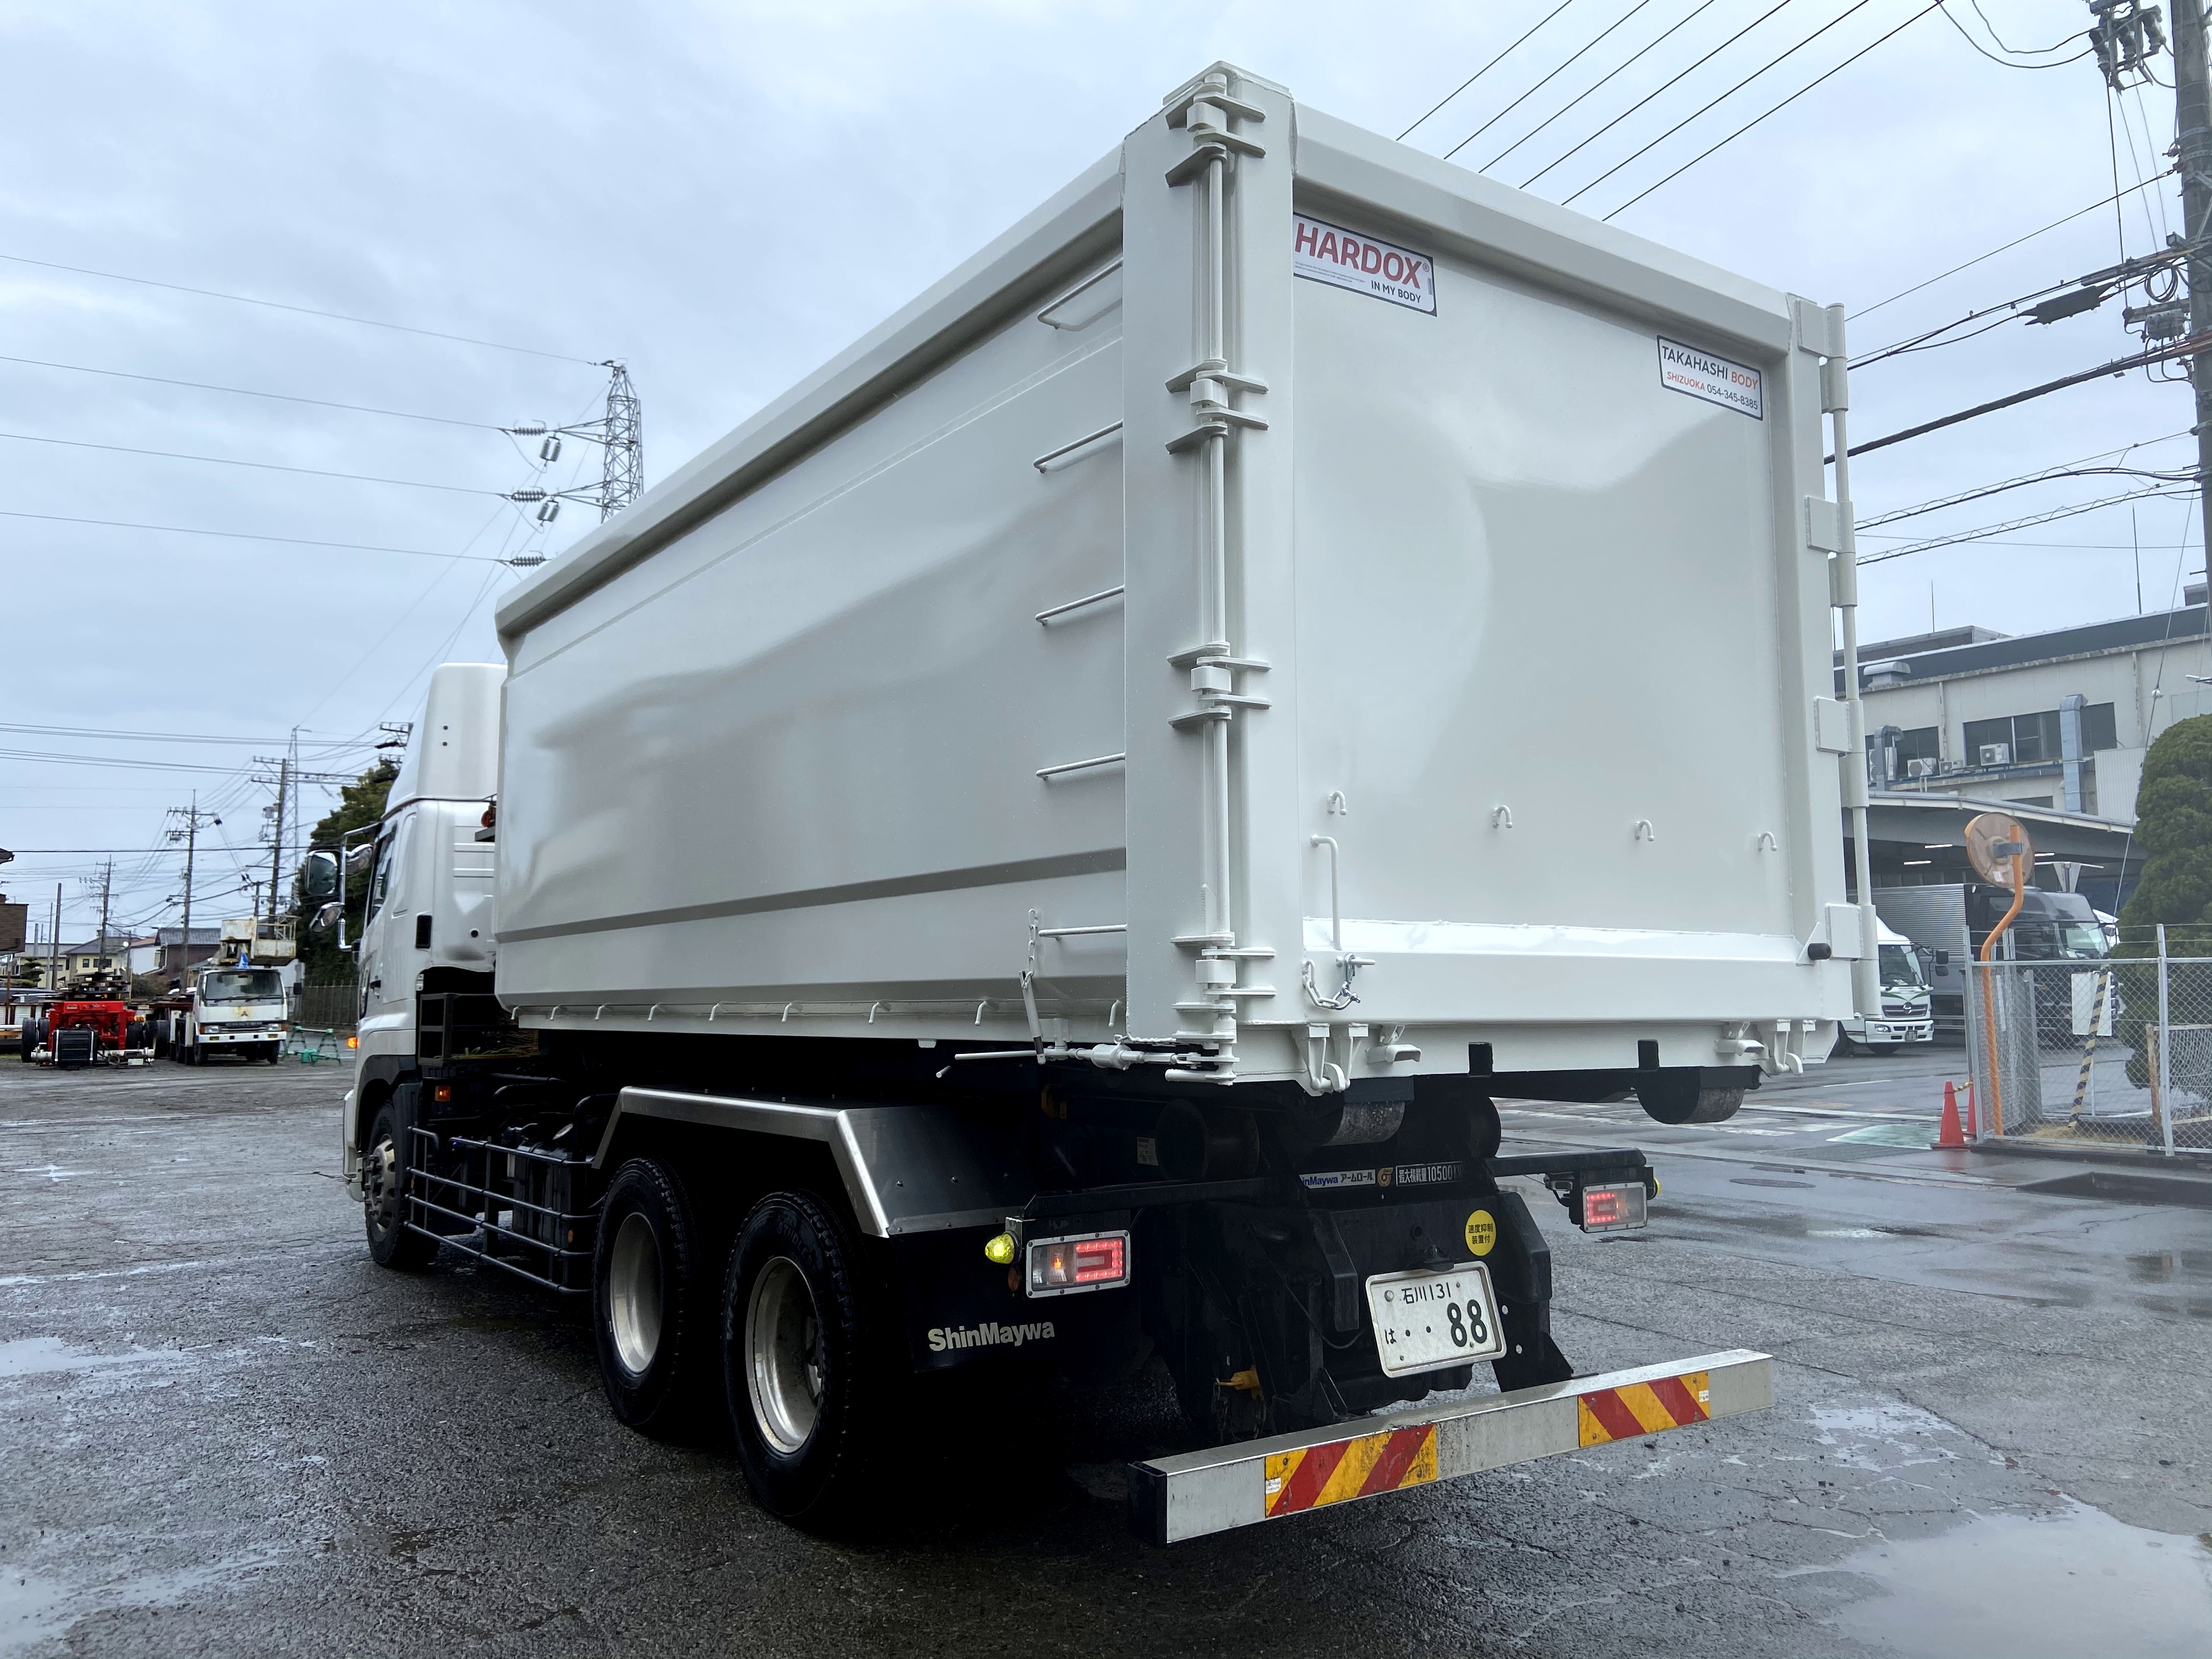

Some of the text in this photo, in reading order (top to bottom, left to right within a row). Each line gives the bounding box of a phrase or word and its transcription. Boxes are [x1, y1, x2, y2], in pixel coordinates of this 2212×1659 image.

[1371, 280, 1421, 303] IN MY BODY
[1662, 346, 1759, 390] TAKAHASHI BODY
[1667, 371, 1758, 410] SHIZUOKA 054-345-8385
[1302, 1172, 1373, 1187] inMaywa アームロール
[1468, 1223, 1493, 1233] 速度抑制
[1472, 1234, 1491, 1244] 装置付
[928, 1322, 1054, 1351] ShinMaywa
[1385, 1328, 1397, 1345] は
